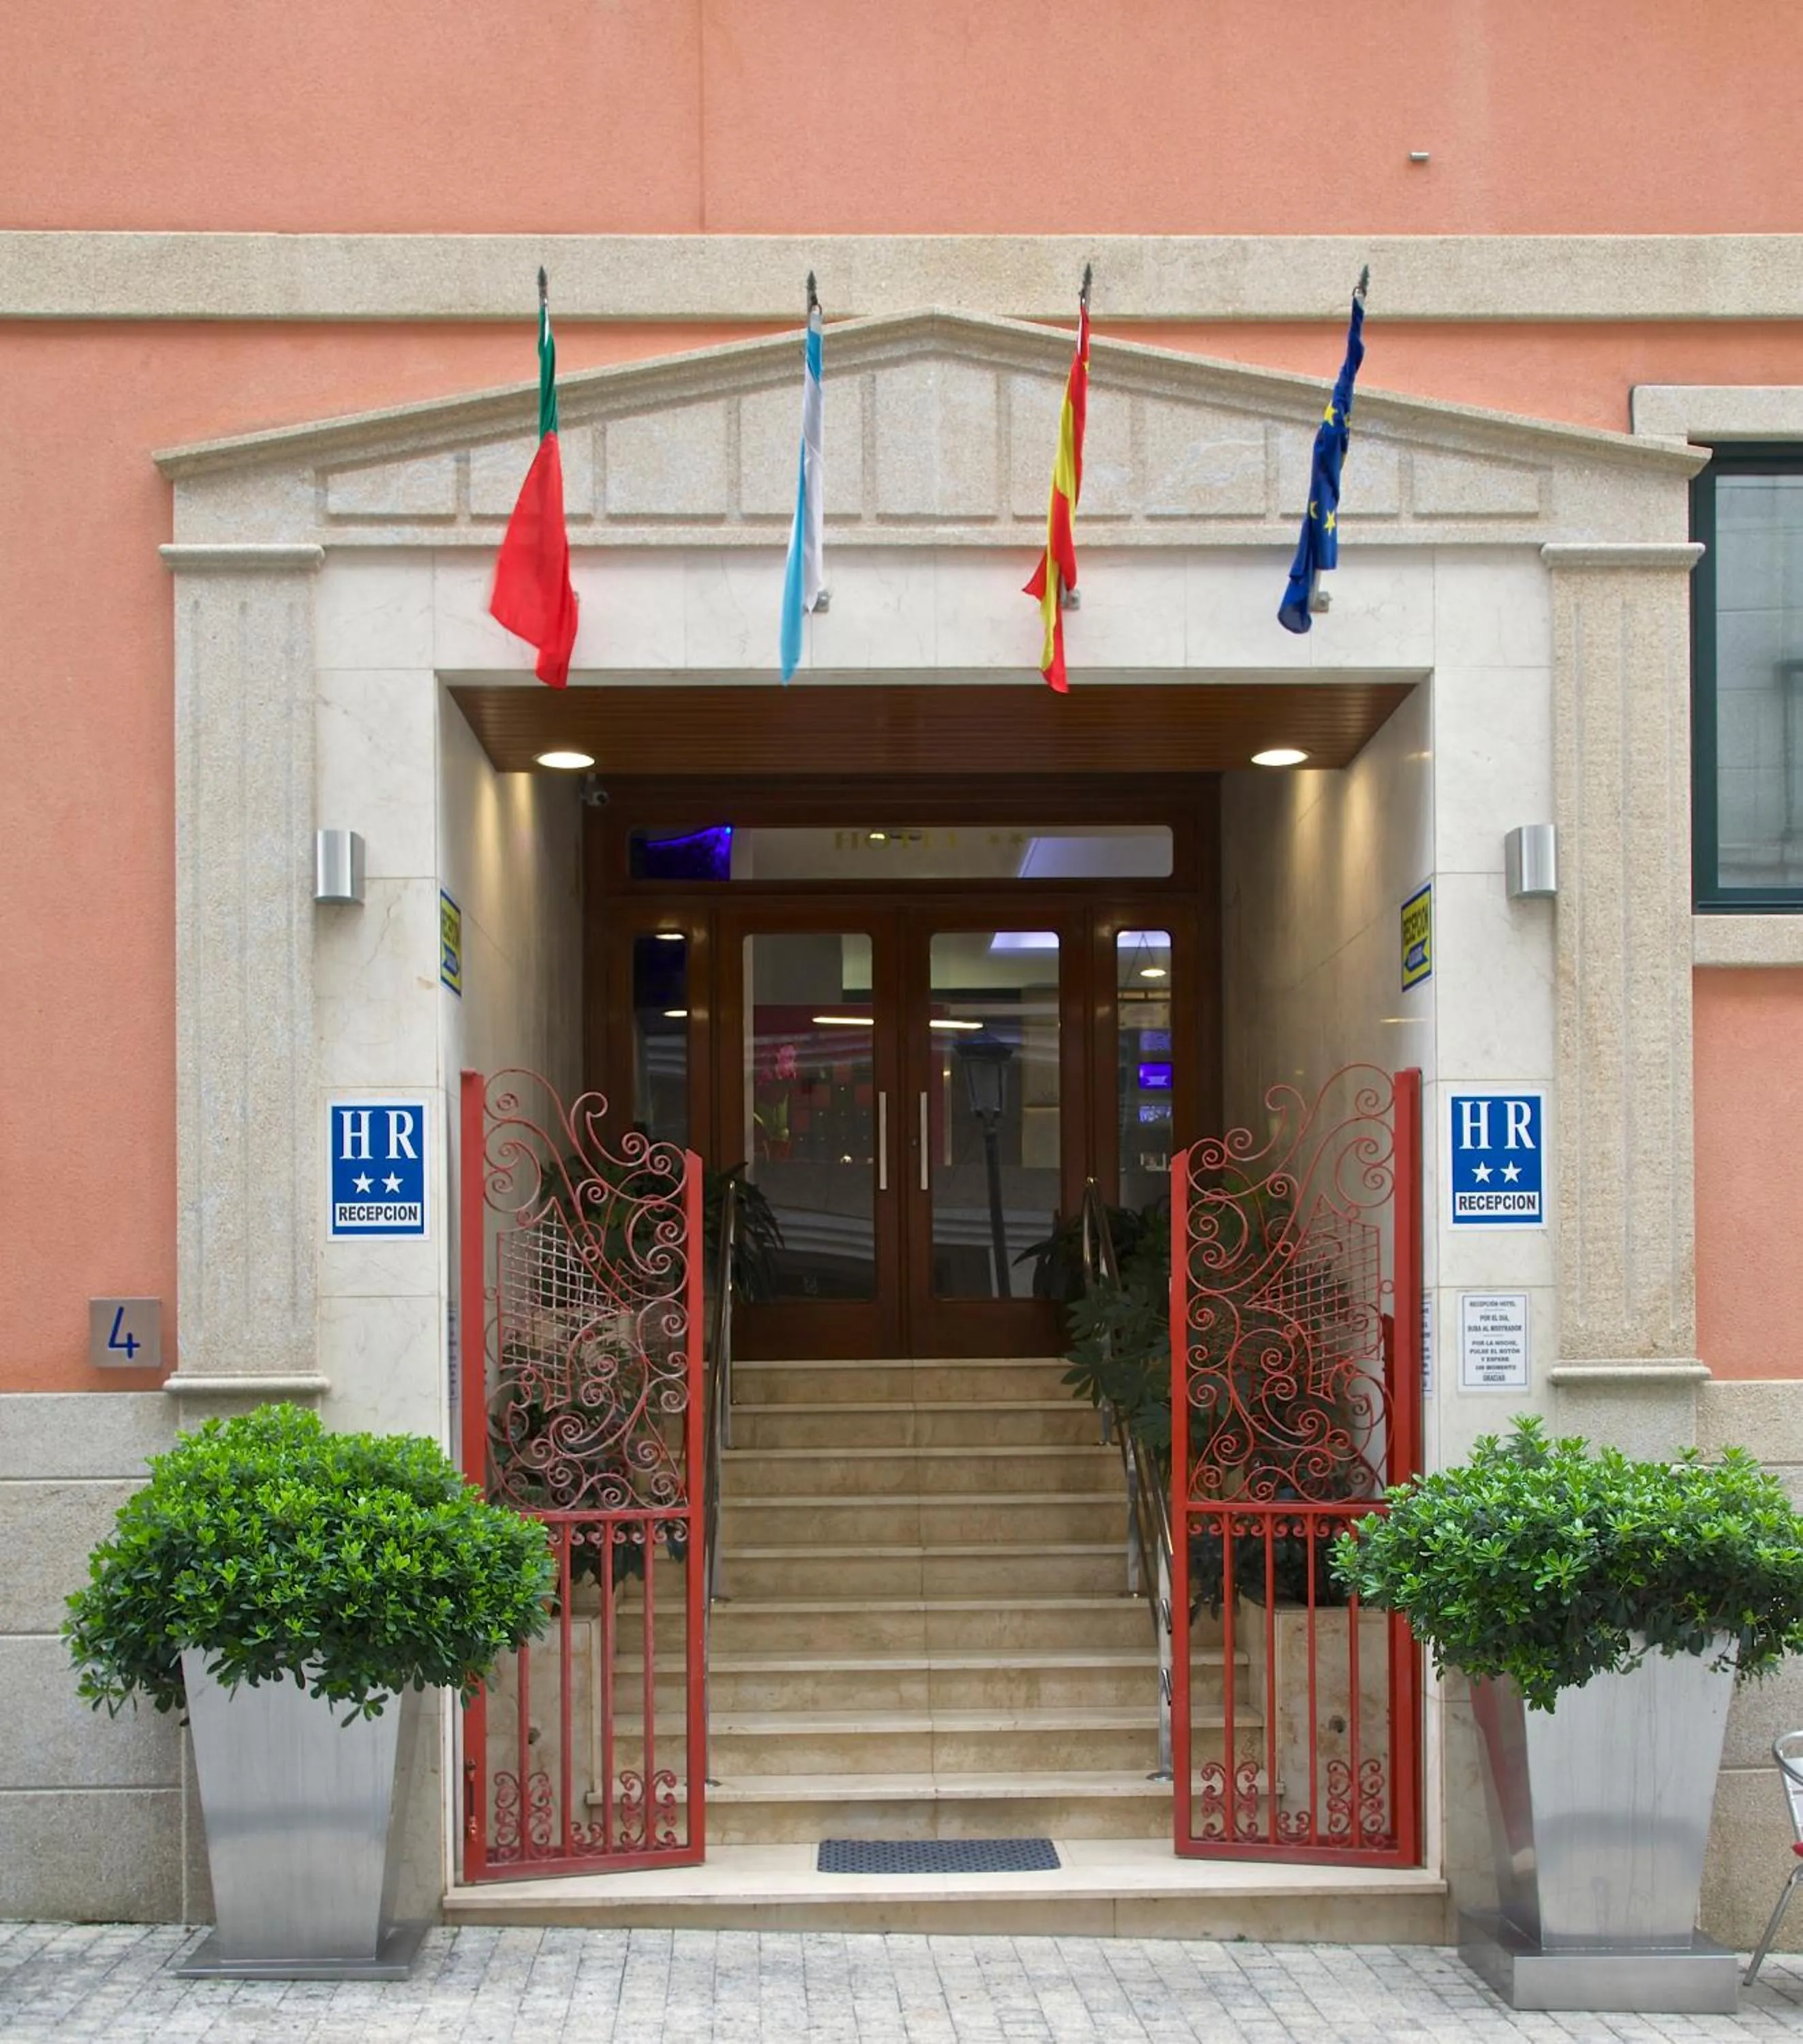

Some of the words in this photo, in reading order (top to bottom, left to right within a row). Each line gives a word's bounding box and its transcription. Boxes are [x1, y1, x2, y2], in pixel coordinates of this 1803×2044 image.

[1459, 1195, 1536, 1211] RECEPCION
[339, 1206, 418, 1222] RECEPCION
[108, 1305, 140, 1359] 4
